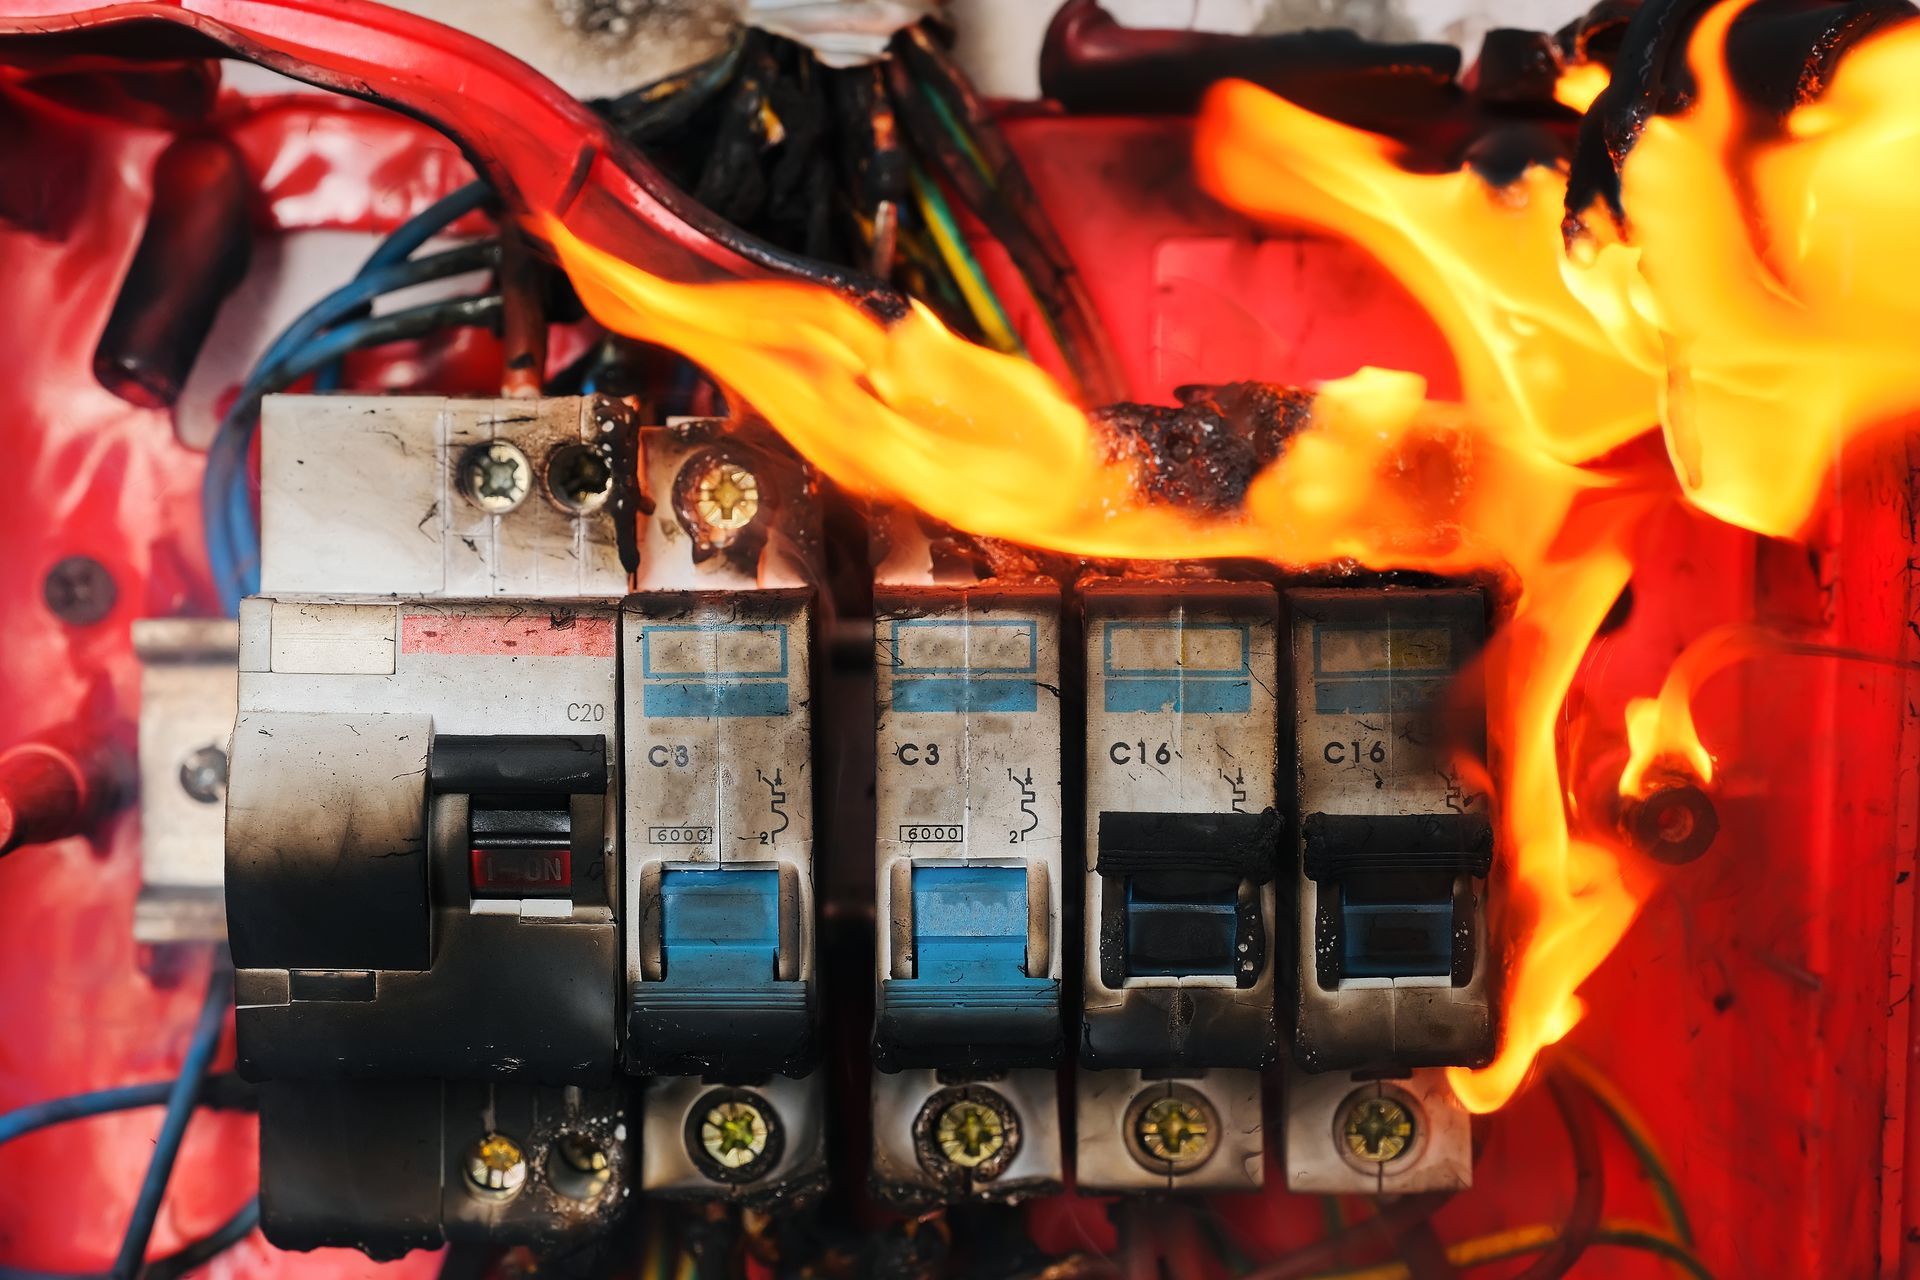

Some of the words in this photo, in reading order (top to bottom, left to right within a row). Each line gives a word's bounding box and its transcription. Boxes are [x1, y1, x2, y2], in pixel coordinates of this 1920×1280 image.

[566, 702, 605, 722] C20
[648, 744, 690, 768] C3
[898, 743, 940, 766] C3
[1109, 741, 1171, 765] C16
[1323, 741, 1386, 764] C16
[1006, 767, 1012, 782] 1
[657, 829, 708, 842] 6000
[907, 827, 959, 840] 6000
[1009, 829, 1018, 844] 2
[526, 857, 563, 881] ON
